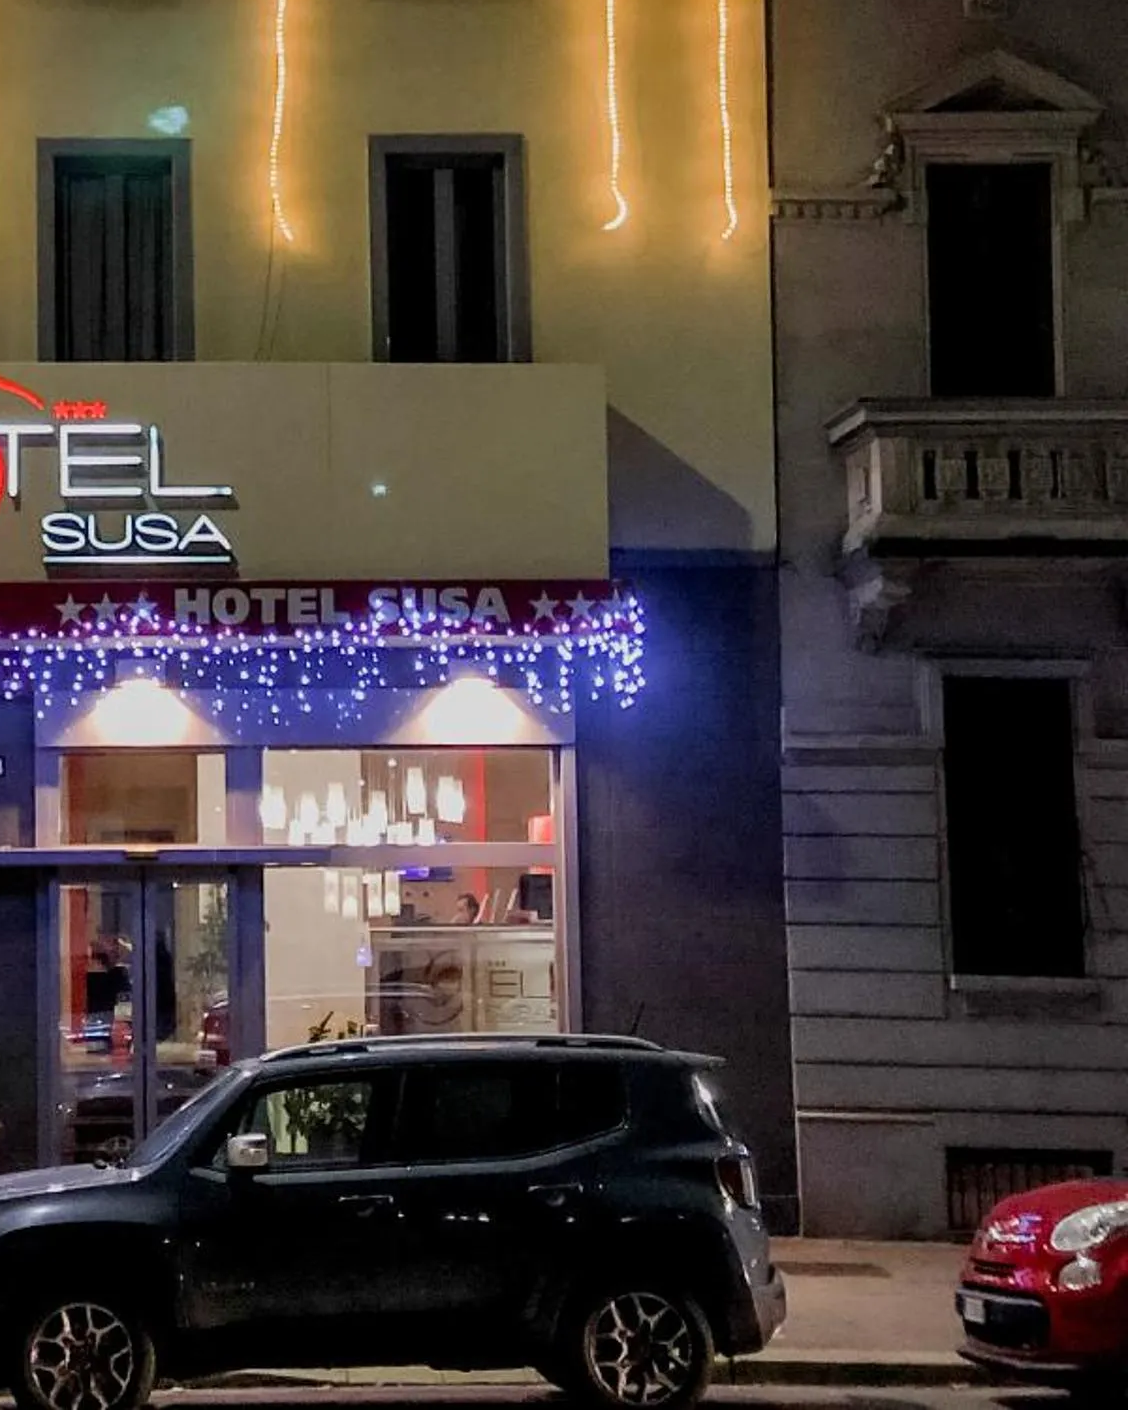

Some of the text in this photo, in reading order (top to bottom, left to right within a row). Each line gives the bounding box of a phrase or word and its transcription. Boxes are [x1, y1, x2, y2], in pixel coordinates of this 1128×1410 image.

[41, 512, 233, 552] SUSA
[173, 587, 511, 626] HOTEL SUSA
